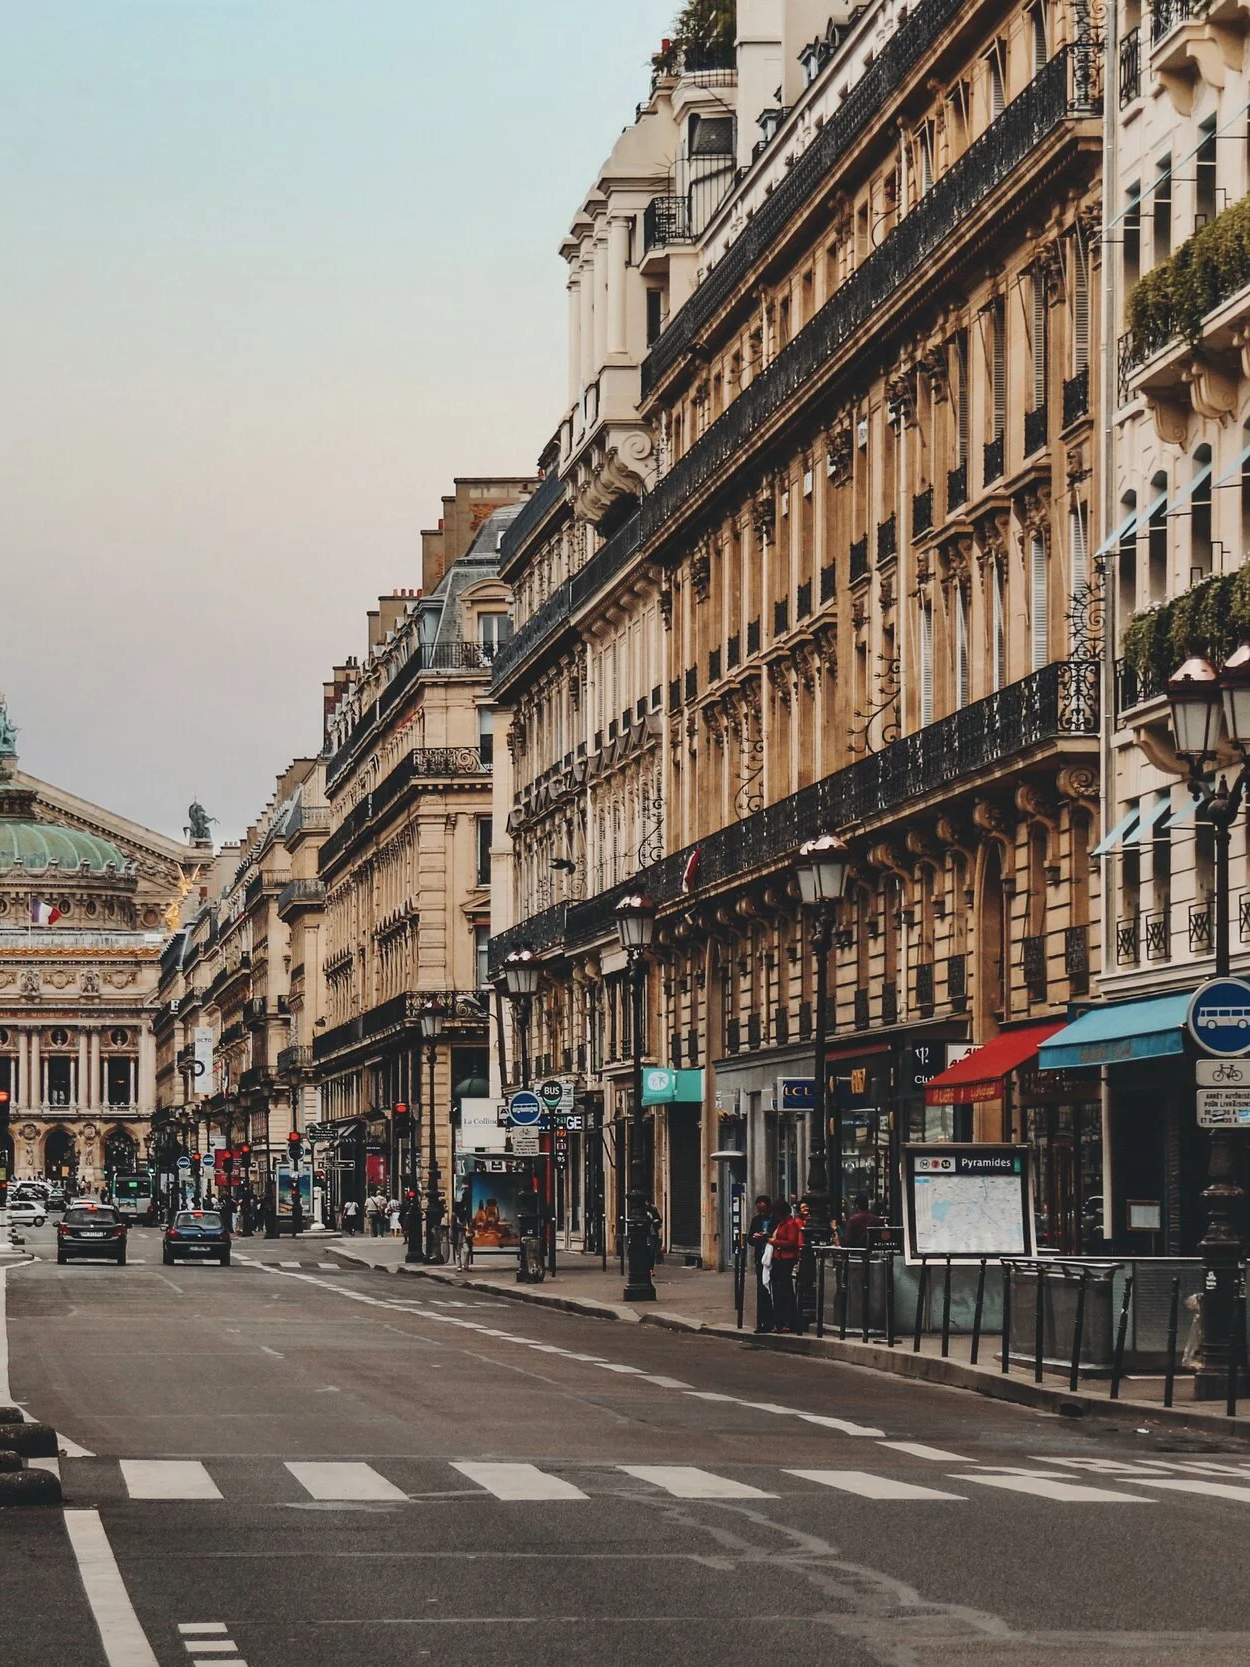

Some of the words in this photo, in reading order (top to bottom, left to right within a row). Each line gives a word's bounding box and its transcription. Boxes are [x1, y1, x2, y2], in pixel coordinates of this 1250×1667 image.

[544, 1086, 560, 1095] BUS
[784, 1087, 813, 1096] LCL
[566, 1116, 582, 1129] GE
[962, 1158, 1011, 1169] Pyramides
